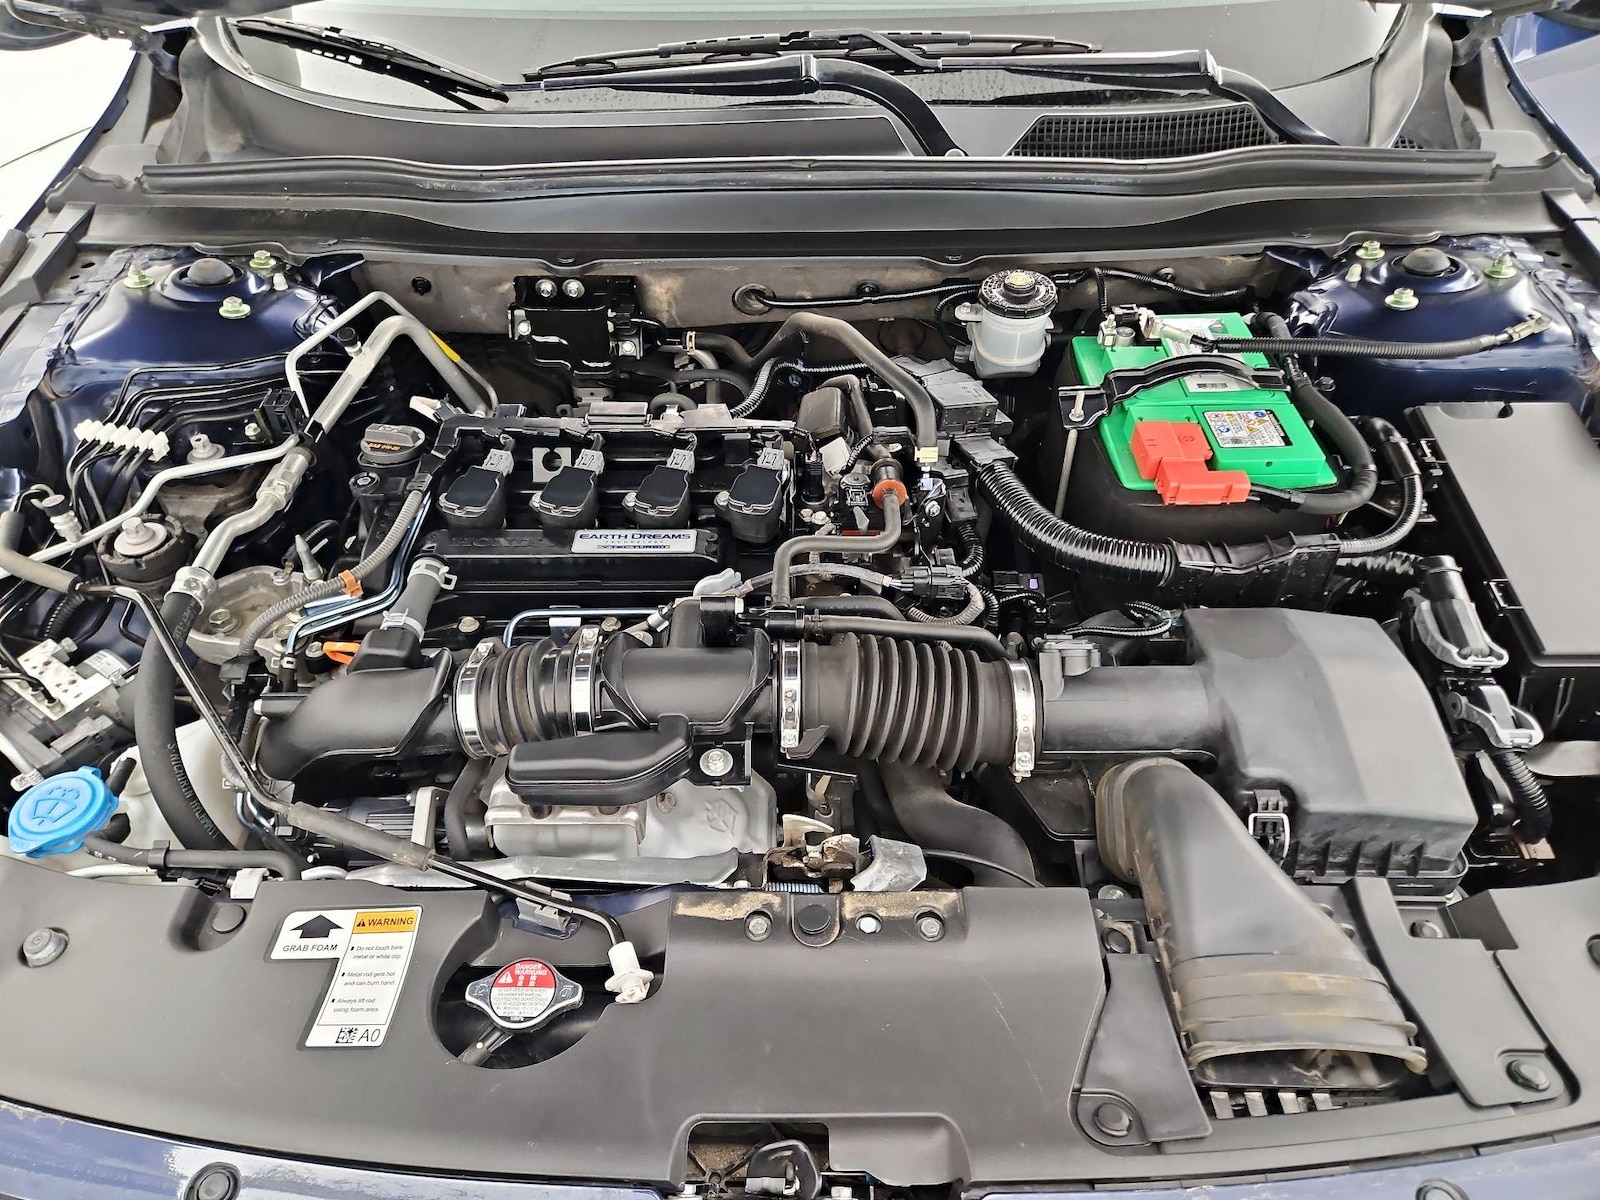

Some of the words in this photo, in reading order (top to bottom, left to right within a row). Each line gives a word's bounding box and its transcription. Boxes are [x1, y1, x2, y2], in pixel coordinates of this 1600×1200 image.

[631, 532, 691, 540] DREAMS
[367, 917, 414, 927] WARNING
[282, 944, 309, 952] GRAB
